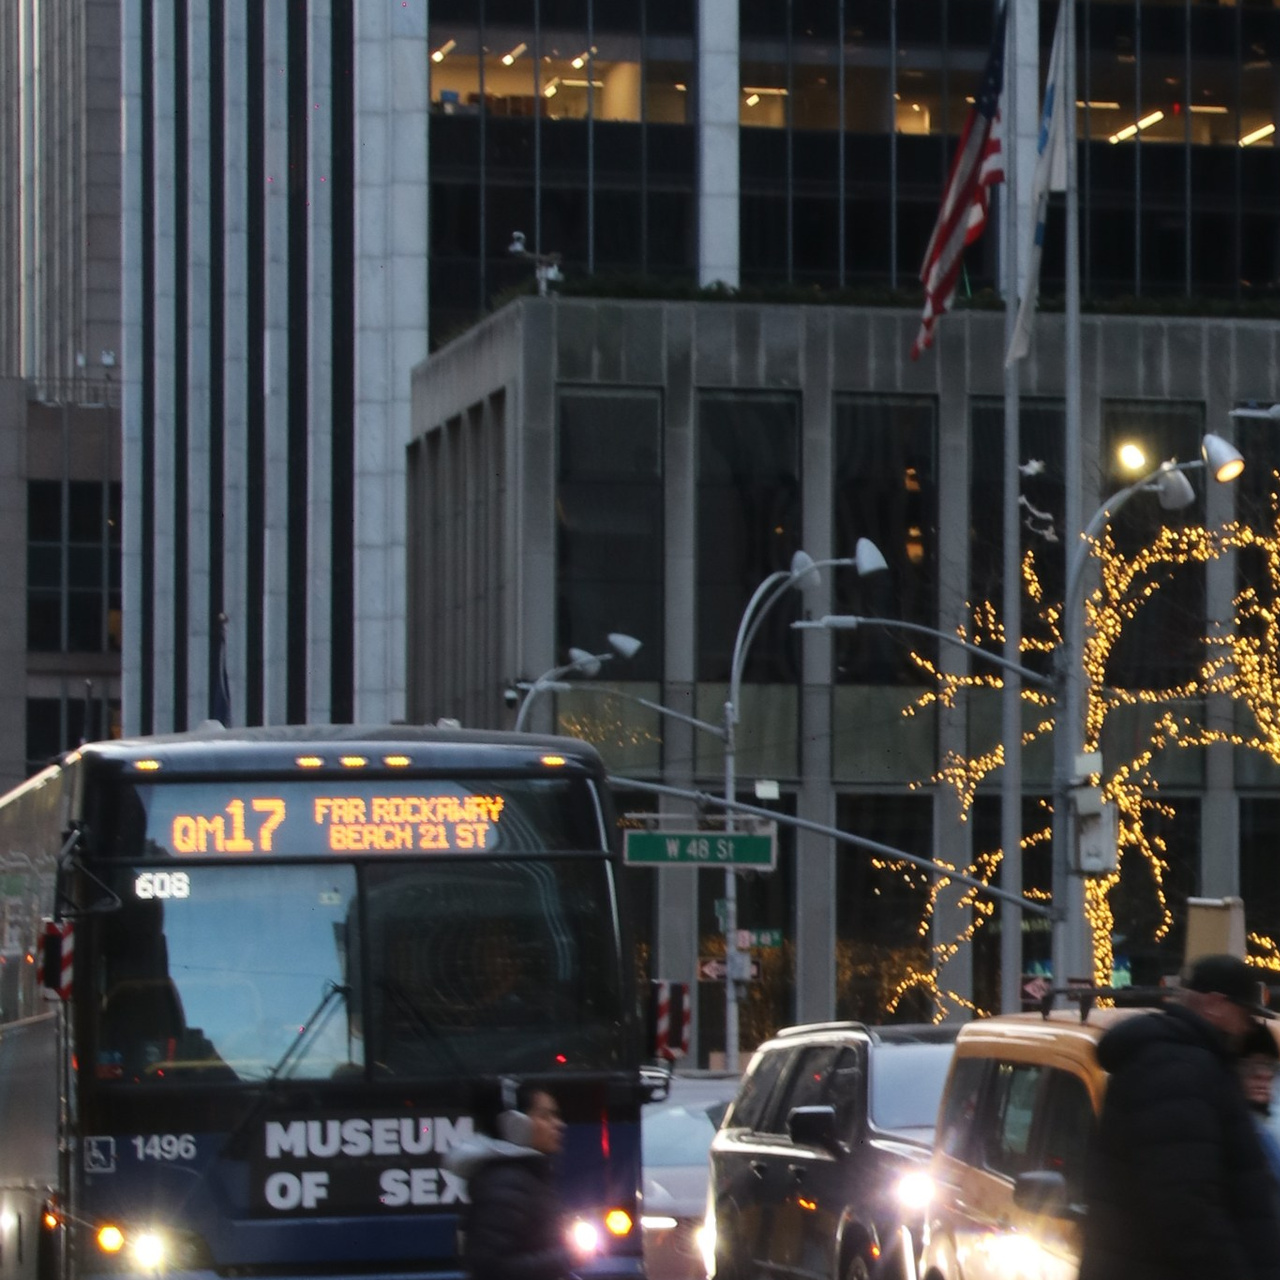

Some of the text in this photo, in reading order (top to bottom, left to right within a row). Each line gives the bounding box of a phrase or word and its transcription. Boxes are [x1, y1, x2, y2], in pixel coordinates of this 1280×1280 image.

[314, 794, 505, 824] FAR ROCKAWAY
[172, 798, 286, 853] QM17
[329, 823, 490, 850] BEACH 21 ST
[665, 838, 735, 859] W 48 St
[135, 872, 190, 899] 608
[131, 1134, 197, 1161] 1496
[264, 1116, 474, 1159] MUSEUM
[264, 1167, 471, 1209] OF SEX
